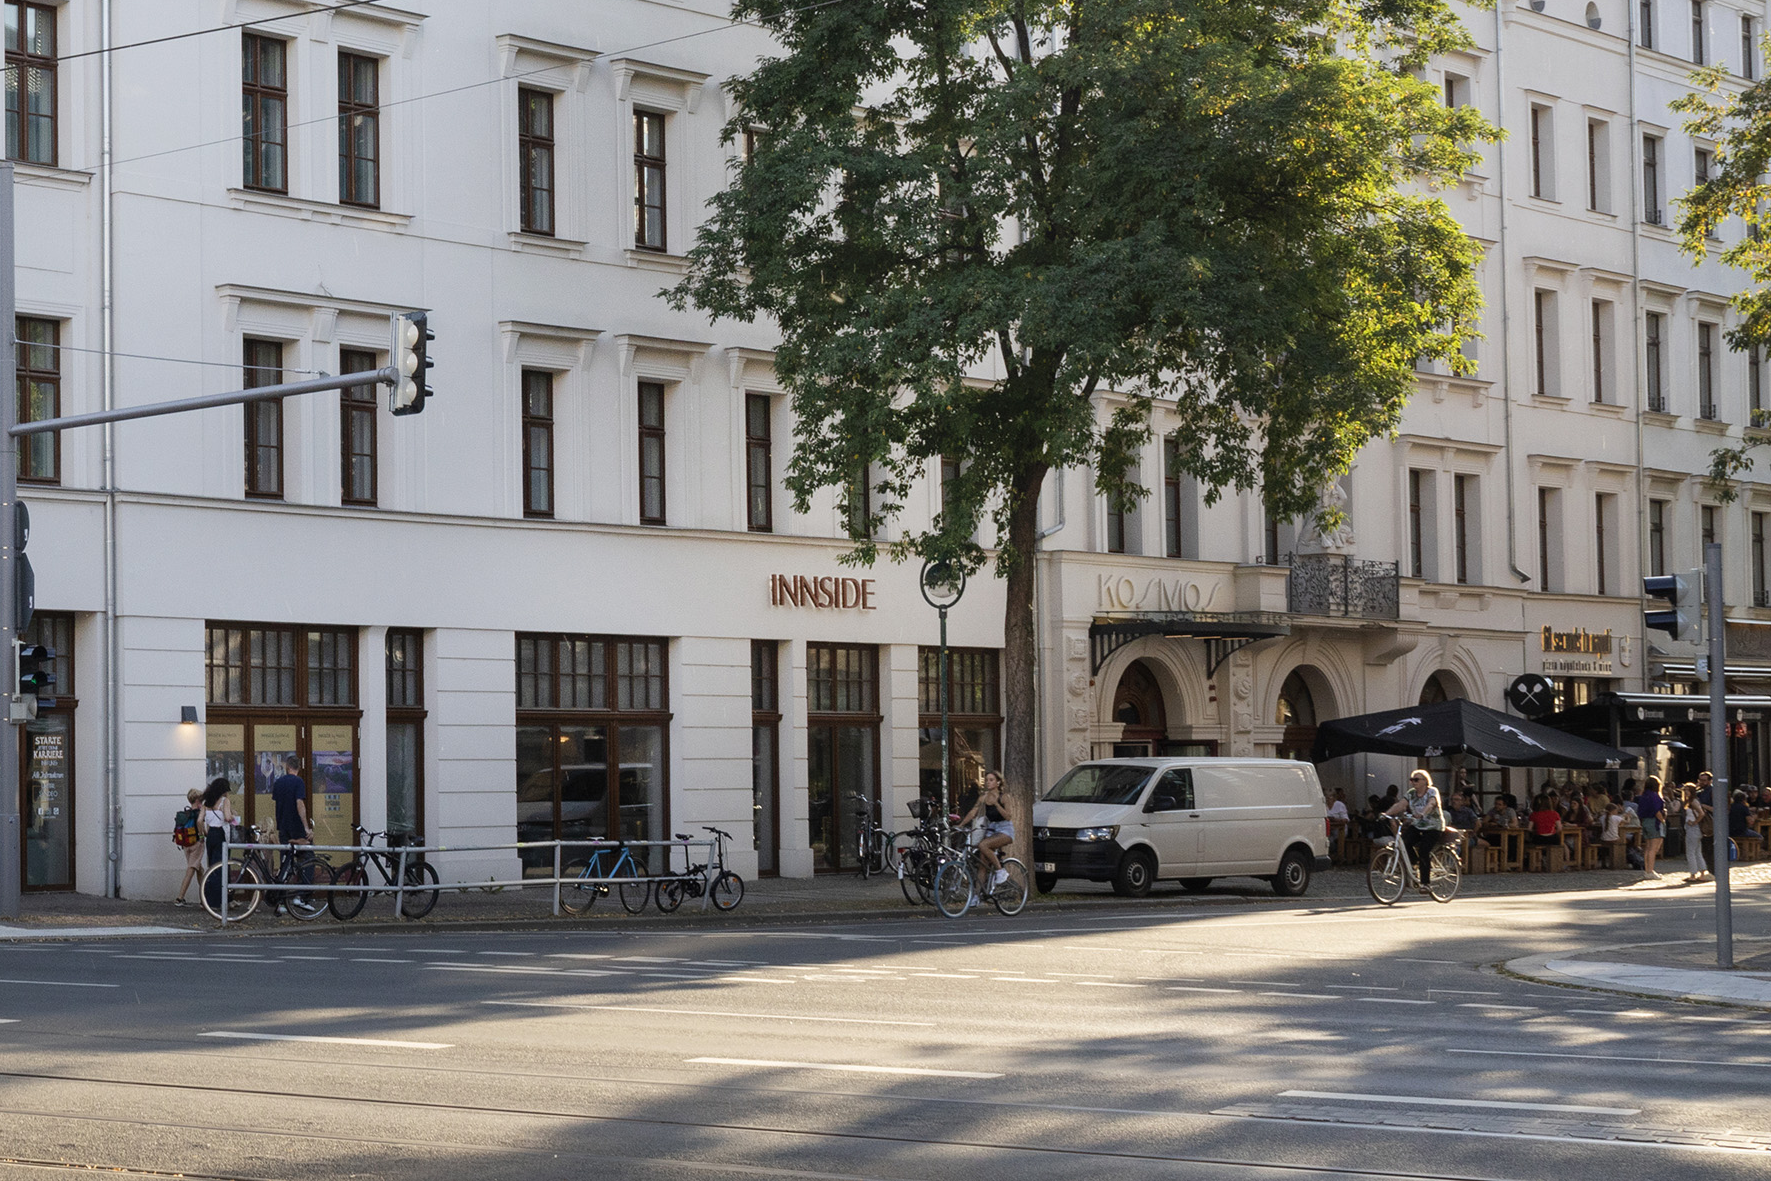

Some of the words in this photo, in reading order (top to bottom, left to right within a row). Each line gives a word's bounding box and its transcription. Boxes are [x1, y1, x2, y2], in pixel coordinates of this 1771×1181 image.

[771, 574, 877, 610] INNSIDE
[1098, 574, 1220, 612] KOSMOS
[35, 736, 62, 745] STARTE
[33, 750, 64, 759] KARRIERE
